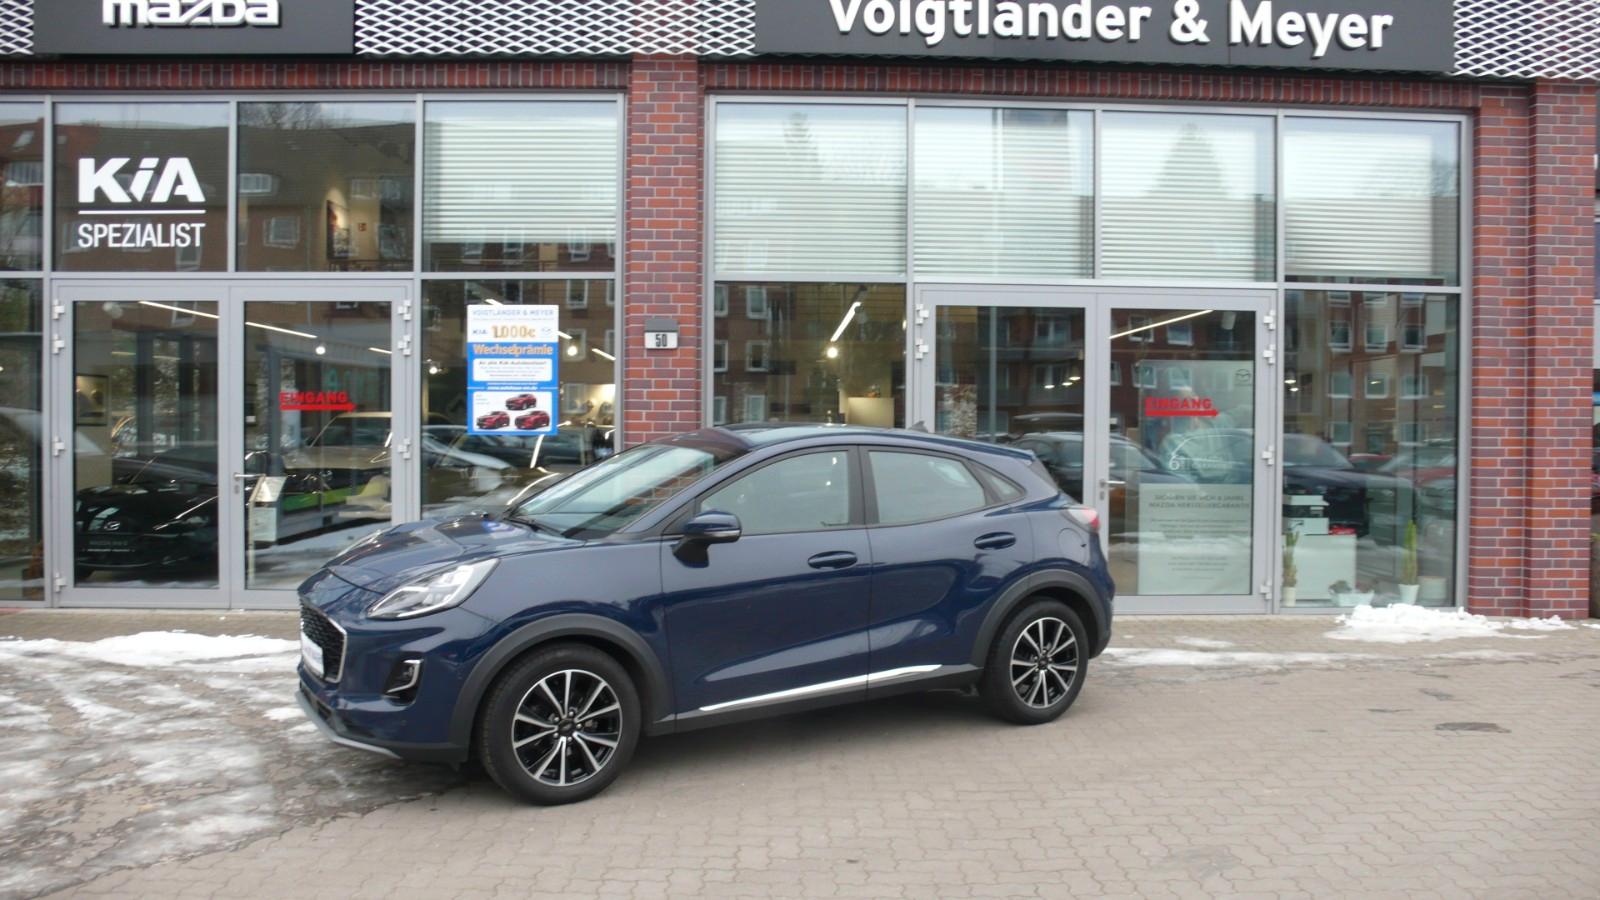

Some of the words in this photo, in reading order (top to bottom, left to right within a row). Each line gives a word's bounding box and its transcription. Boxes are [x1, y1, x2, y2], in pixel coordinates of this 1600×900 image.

[1168, 0, 1210, 43] &
[1230, 0, 1394, 57] Meyer
[78, 223, 206, 248] SPEZIALIST
[655, 333, 667, 347] 50
[279, 391, 348, 403] EINGANG
[1145, 396, 1212, 409] EINGANG
